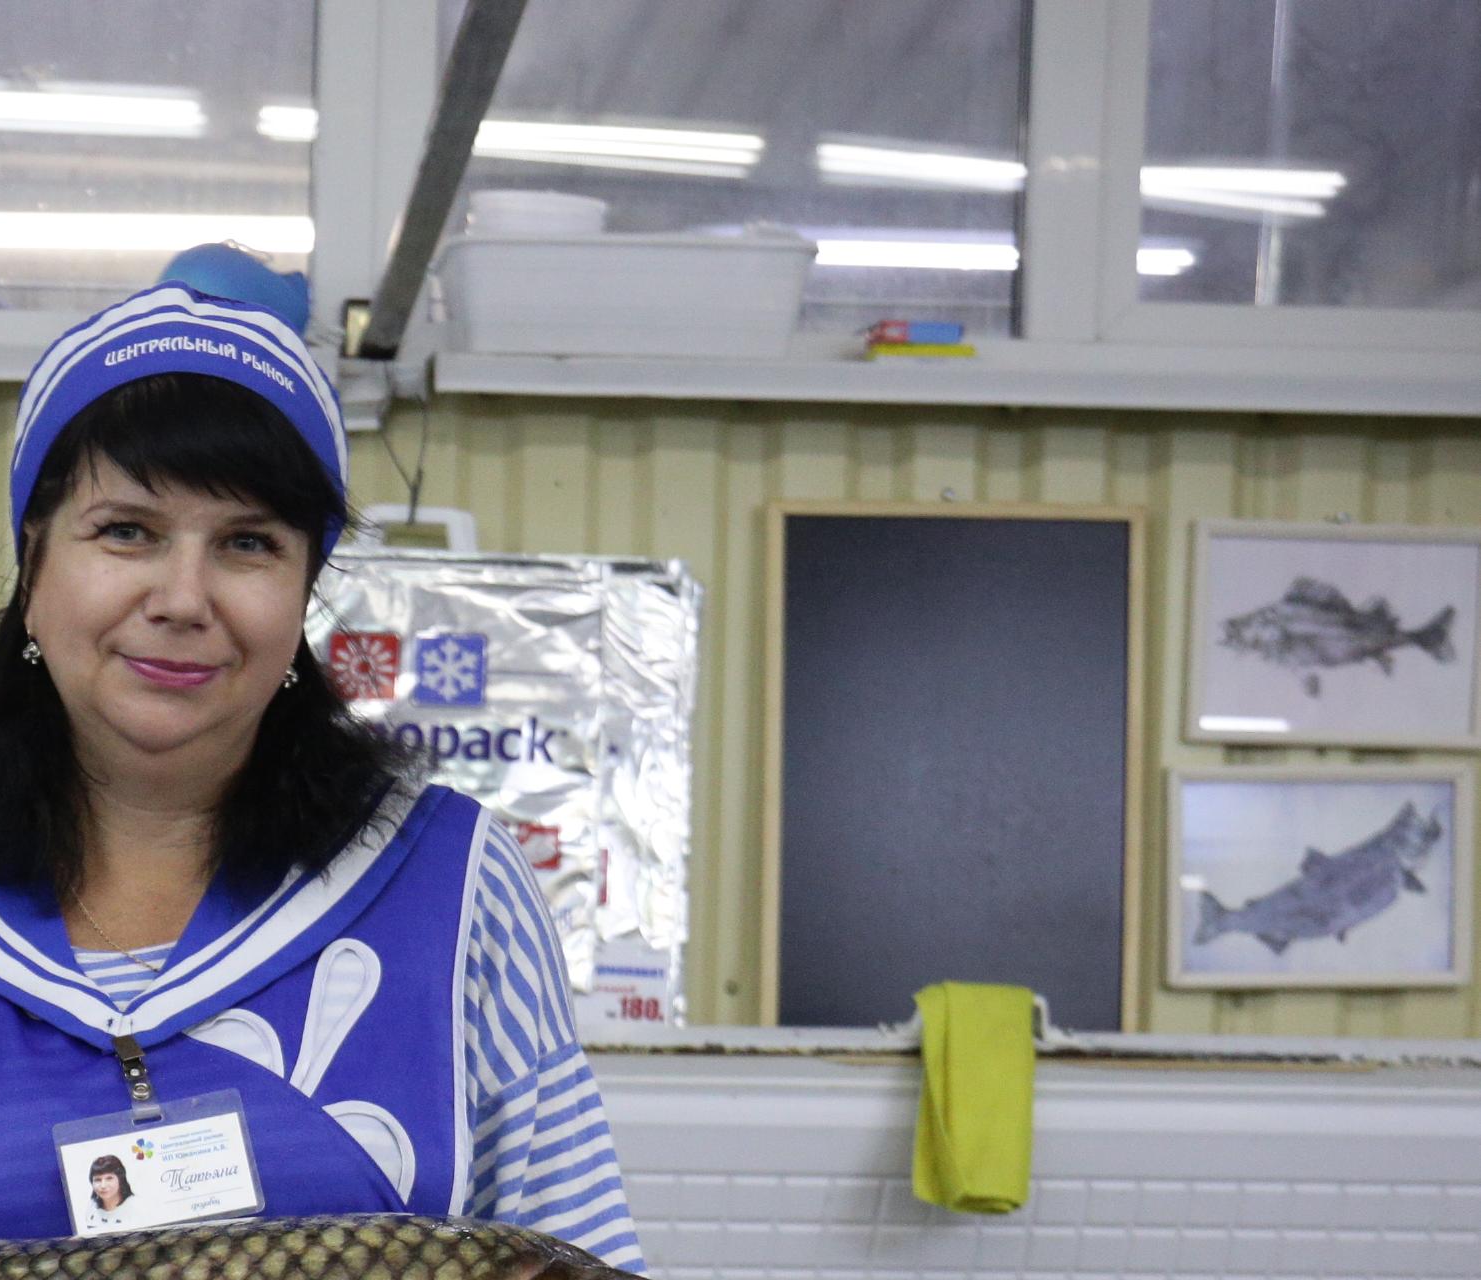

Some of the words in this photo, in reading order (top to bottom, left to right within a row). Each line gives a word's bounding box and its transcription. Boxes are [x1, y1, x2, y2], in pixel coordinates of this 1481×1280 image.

[104, 336, 237, 367] ЦЕНТРАЛЬНЫЙ
[241, 351, 295, 394] РЫНОК
[160, 1165, 239, 1192] Татьяна
